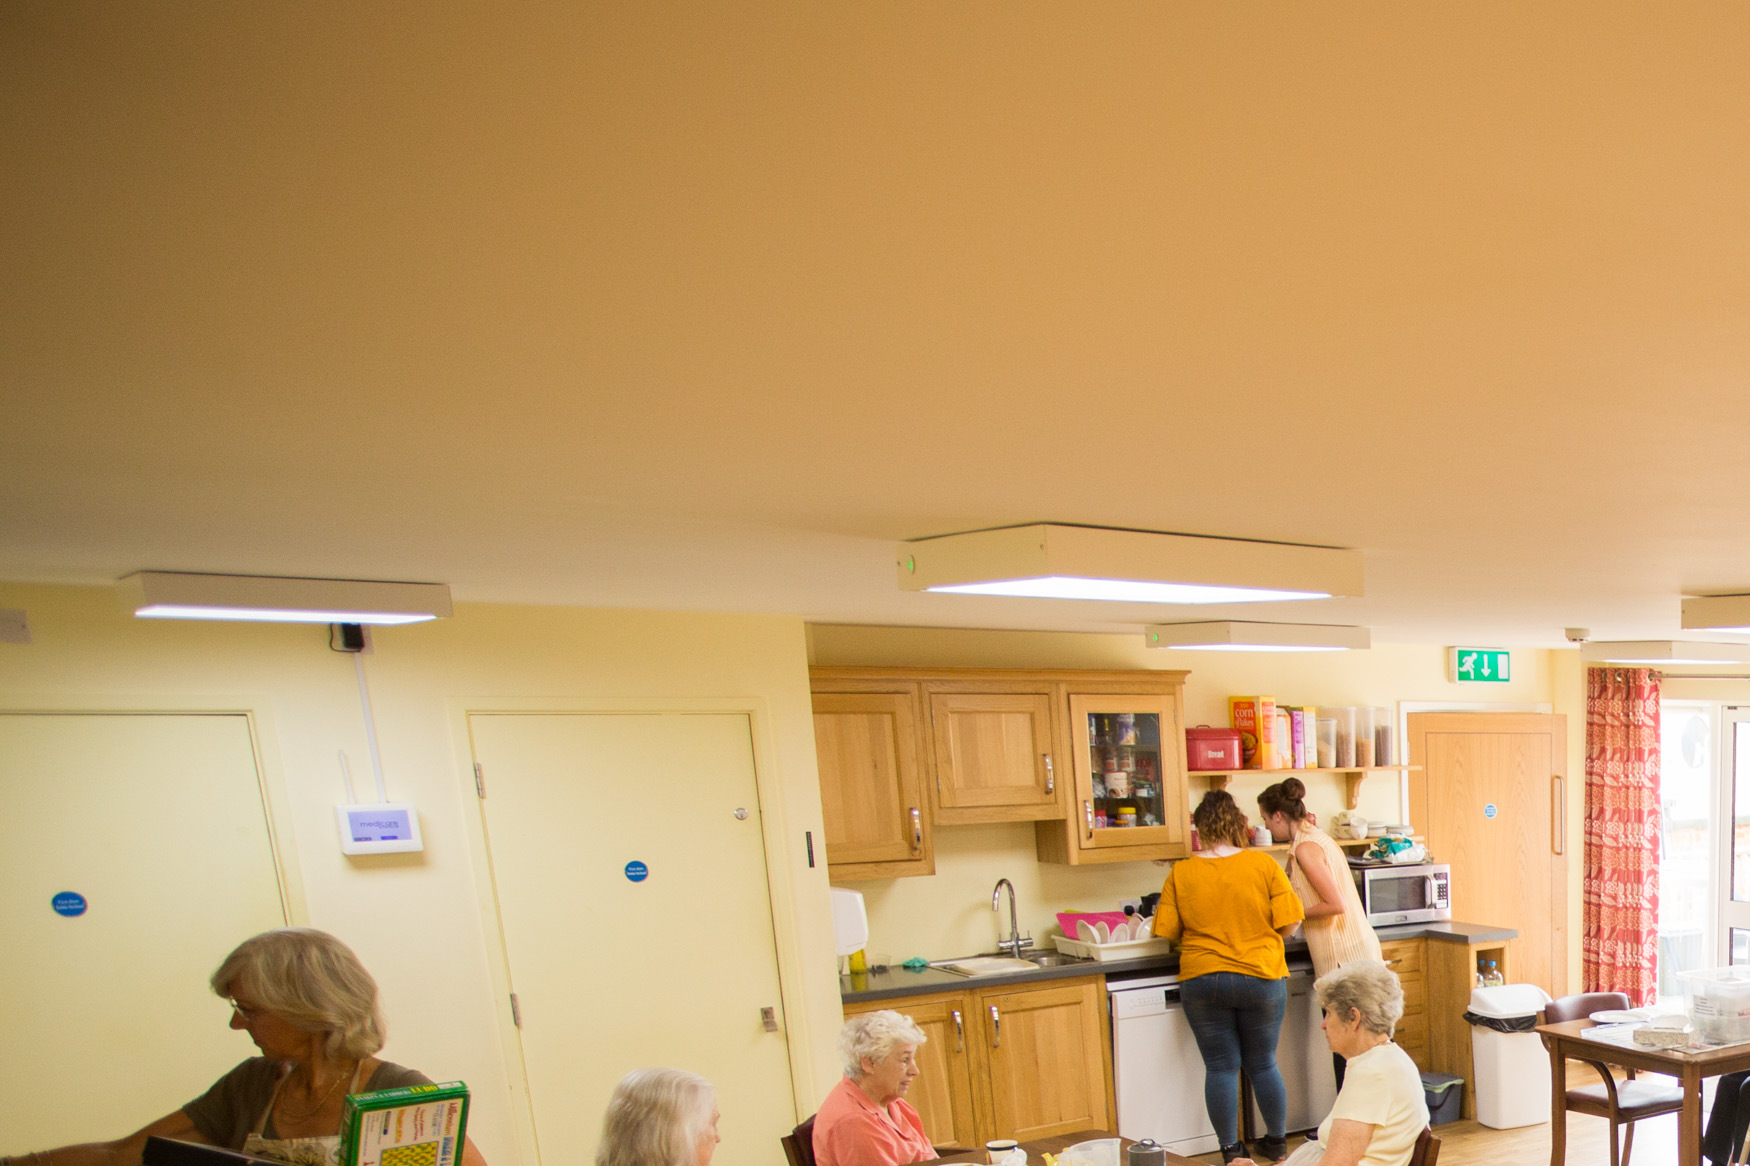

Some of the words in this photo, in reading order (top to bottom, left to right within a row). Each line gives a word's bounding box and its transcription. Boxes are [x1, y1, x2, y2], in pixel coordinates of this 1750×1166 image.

[1235, 708, 1254, 718] corn
[1235, 718, 1254, 728] flakes
[1208, 750, 1224, 758] Bread
